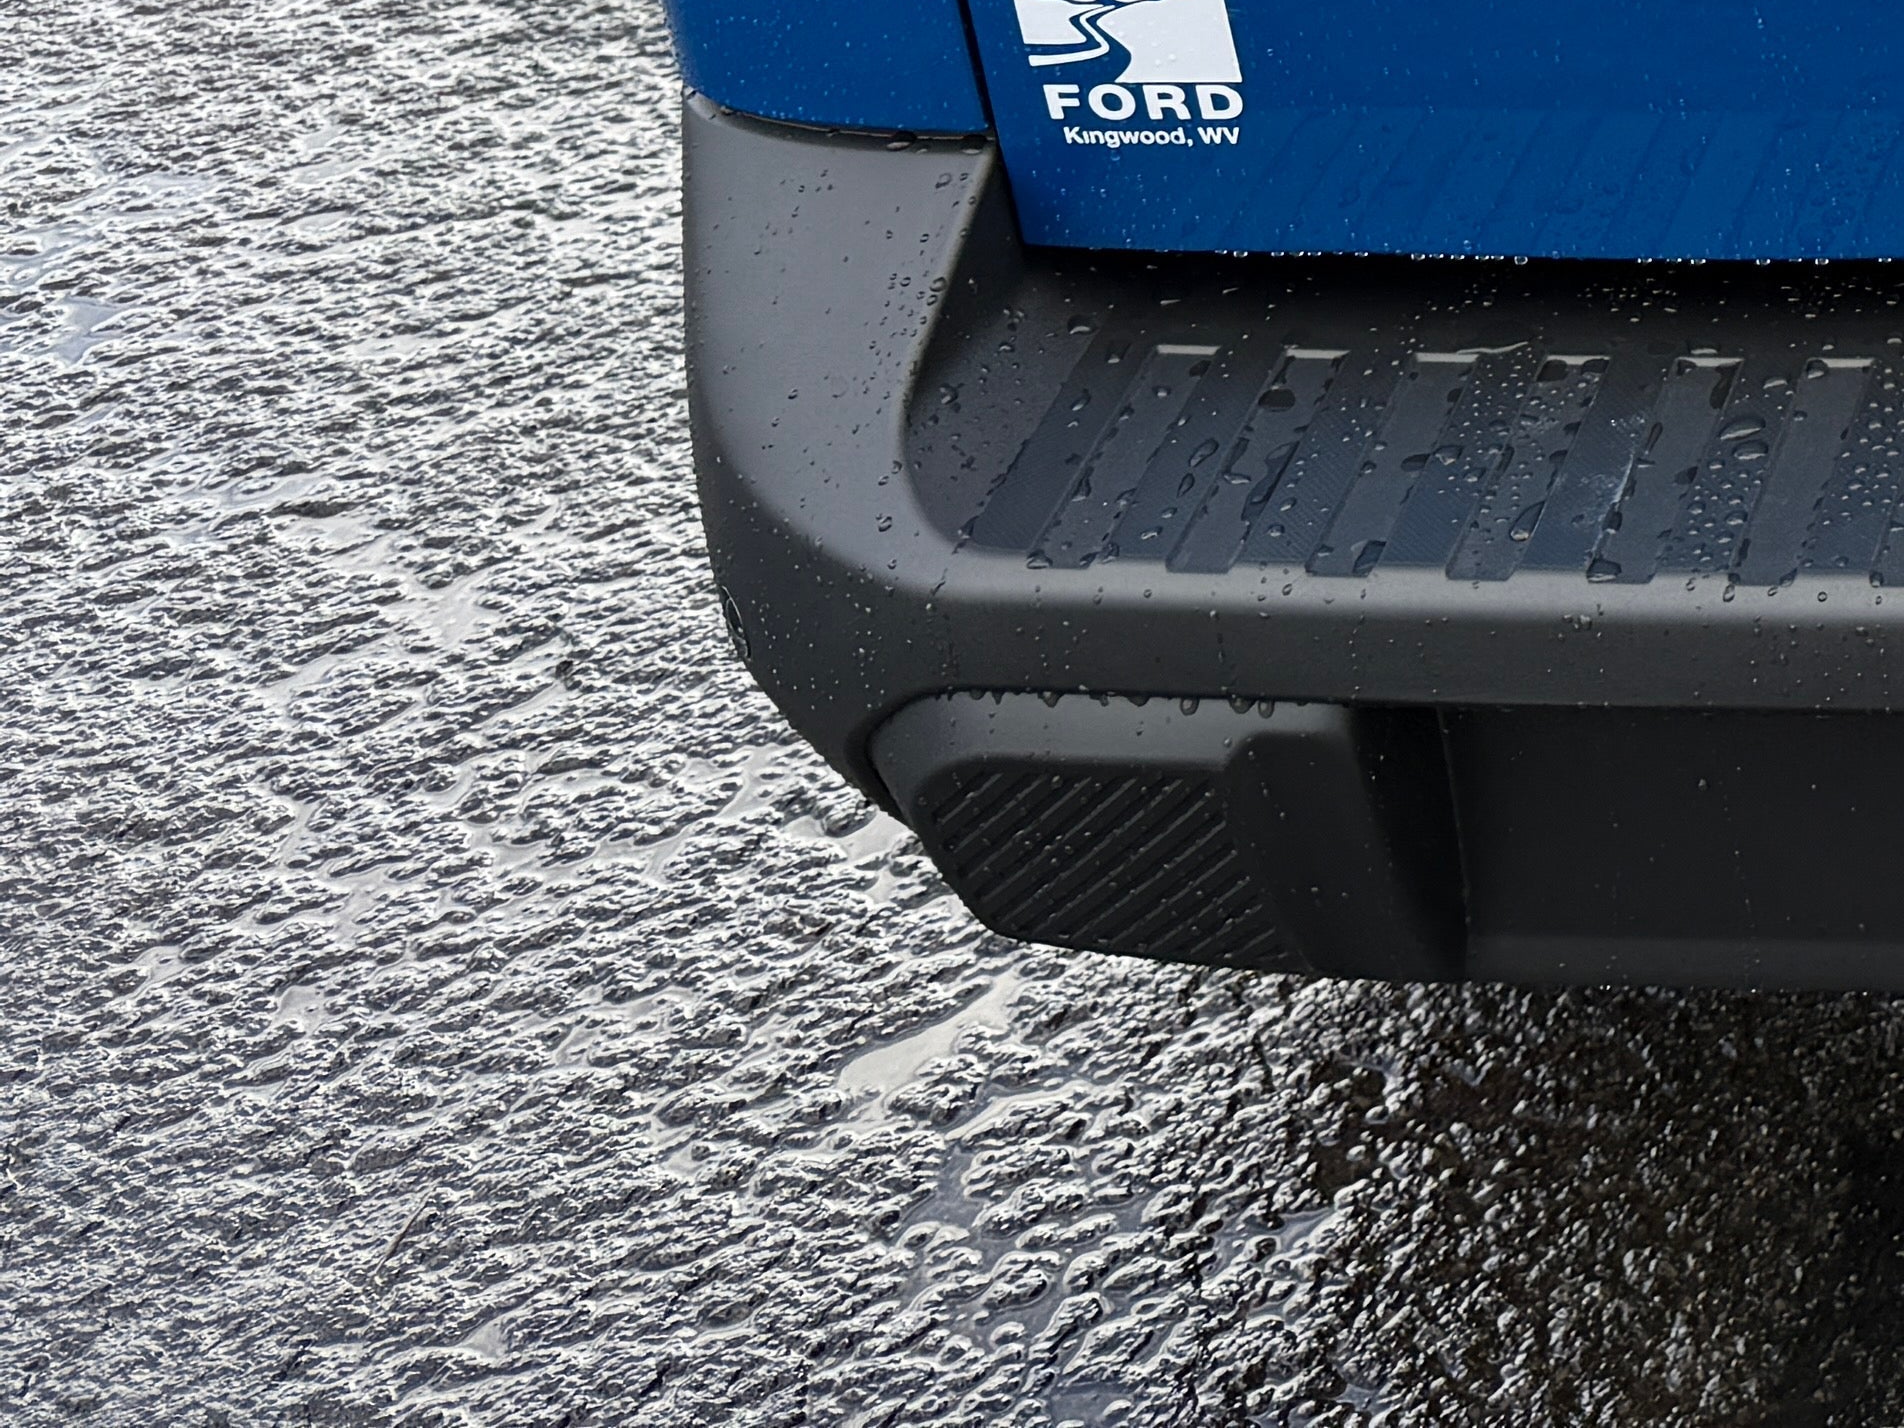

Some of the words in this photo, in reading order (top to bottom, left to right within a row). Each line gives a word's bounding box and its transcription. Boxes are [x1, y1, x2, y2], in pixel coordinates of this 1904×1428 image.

[1042, 84, 1244, 121] FORD
[1062, 126, 1194, 149] Kingwood,
[1198, 126, 1240, 145] WV
